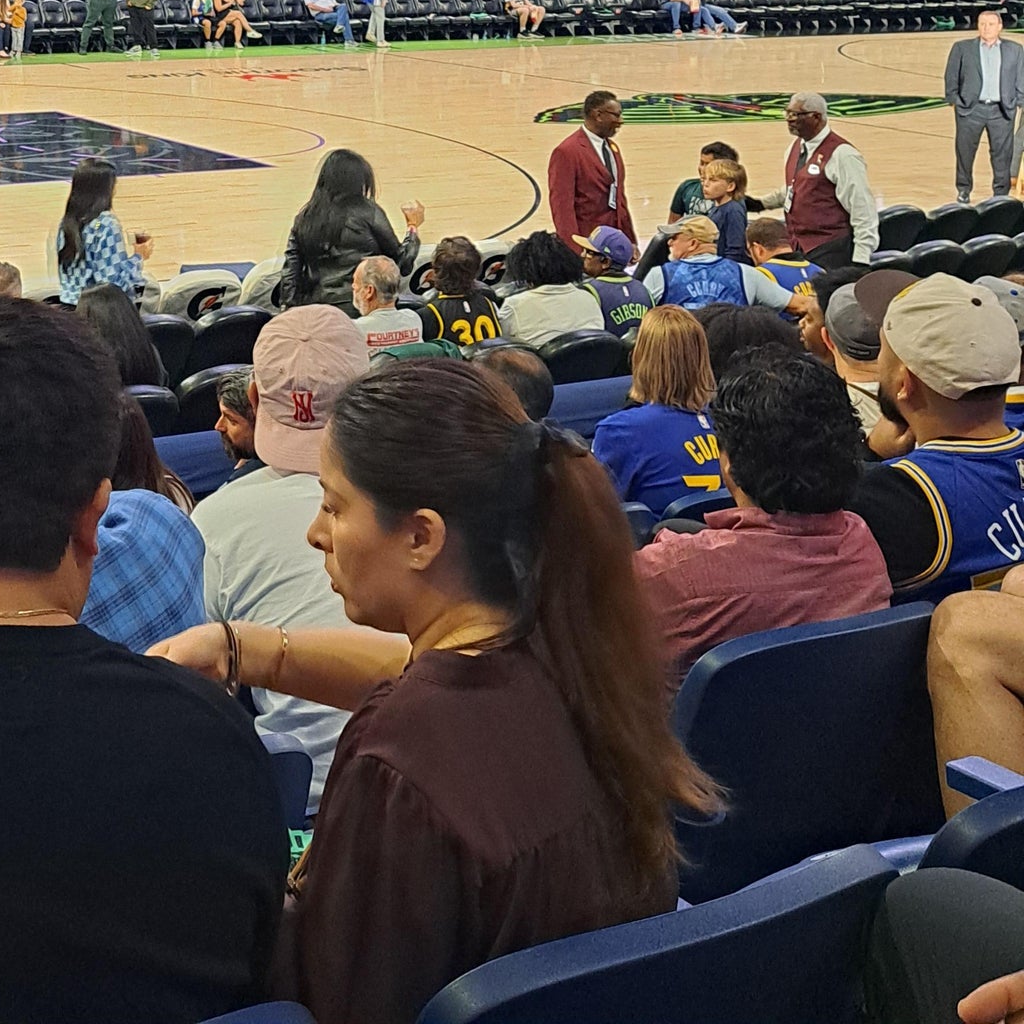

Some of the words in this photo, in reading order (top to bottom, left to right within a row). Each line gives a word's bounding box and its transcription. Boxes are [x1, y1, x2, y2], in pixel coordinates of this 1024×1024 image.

[686, 281, 726, 298] CURRY
[610, 304, 649, 326] GIBSON
[451, 315, 496, 345] 30
[683, 433, 720, 465] CUR
